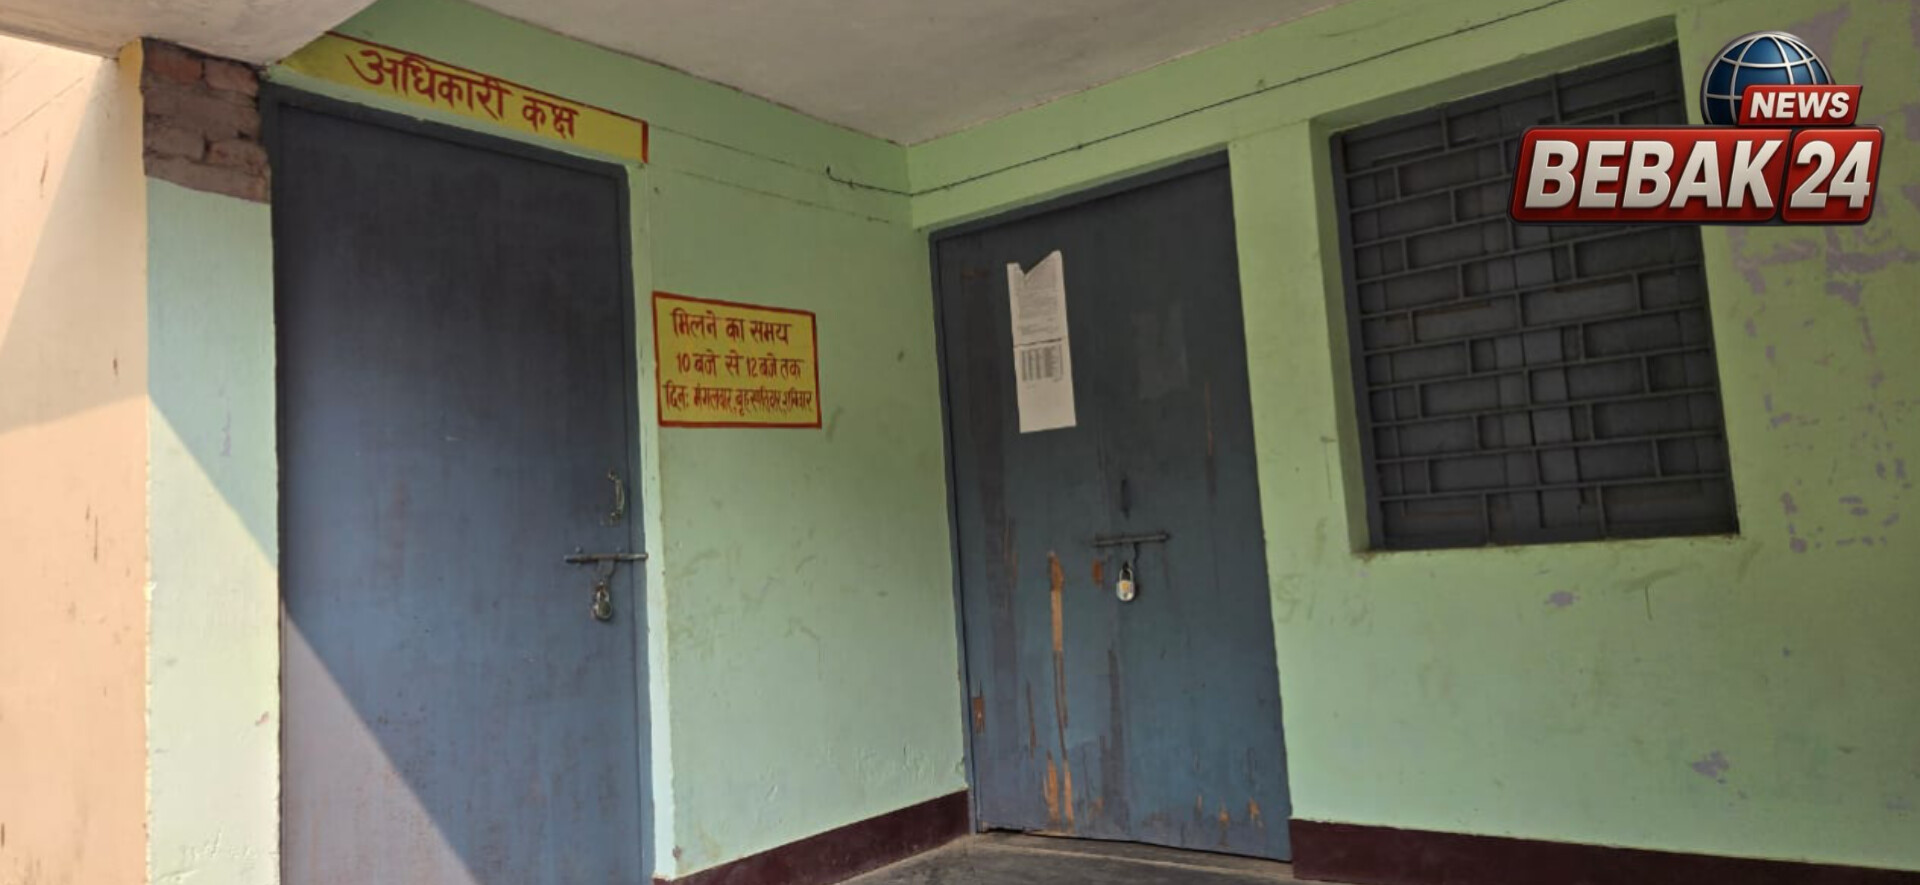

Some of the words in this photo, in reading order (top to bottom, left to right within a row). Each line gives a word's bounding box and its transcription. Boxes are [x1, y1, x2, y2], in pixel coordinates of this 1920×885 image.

[345, 49, 512, 121] अधिकारी
[522, 94, 580, 140] कक्ष
[670, 307, 719, 340] मिलने
[725, 317, 746, 342] का
[750, 319, 793, 345] समय
[676, 352, 690, 374] 10
[692, 348, 720, 377] बजे
[725, 349, 744, 378] से
[747, 356, 758, 379] 12
[758, 352, 778, 379] बजे
[778, 358, 805, 380] तक
